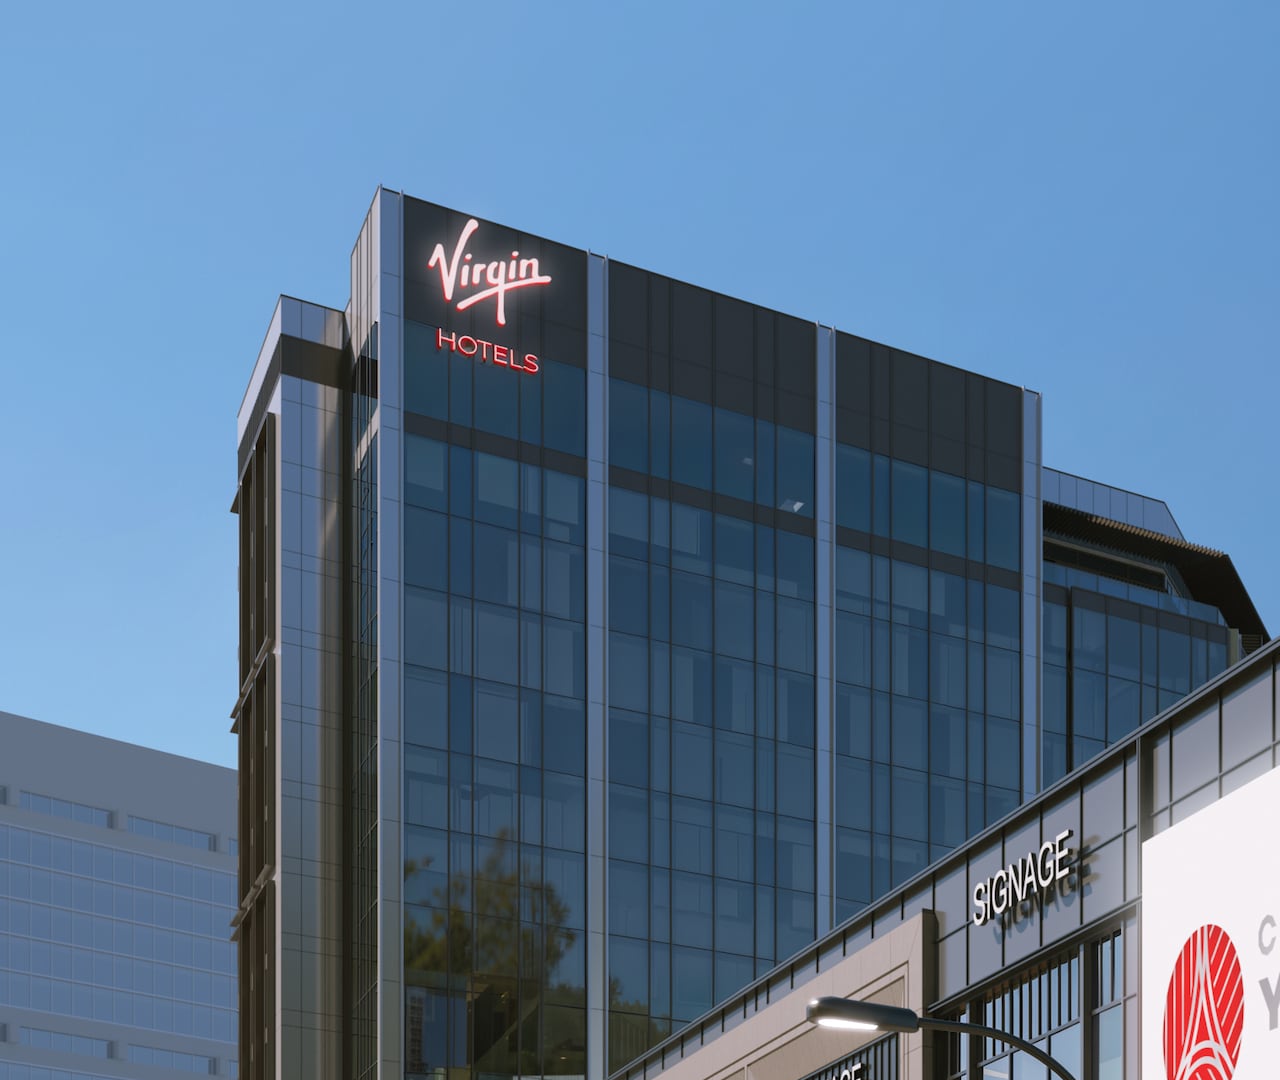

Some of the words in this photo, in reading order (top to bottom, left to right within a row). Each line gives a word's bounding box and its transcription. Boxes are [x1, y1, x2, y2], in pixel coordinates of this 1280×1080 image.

[429, 218, 552, 325] Virgin
[436, 327, 539, 374] HOTELS
[972, 829, 1071, 927] SIGNAGE
